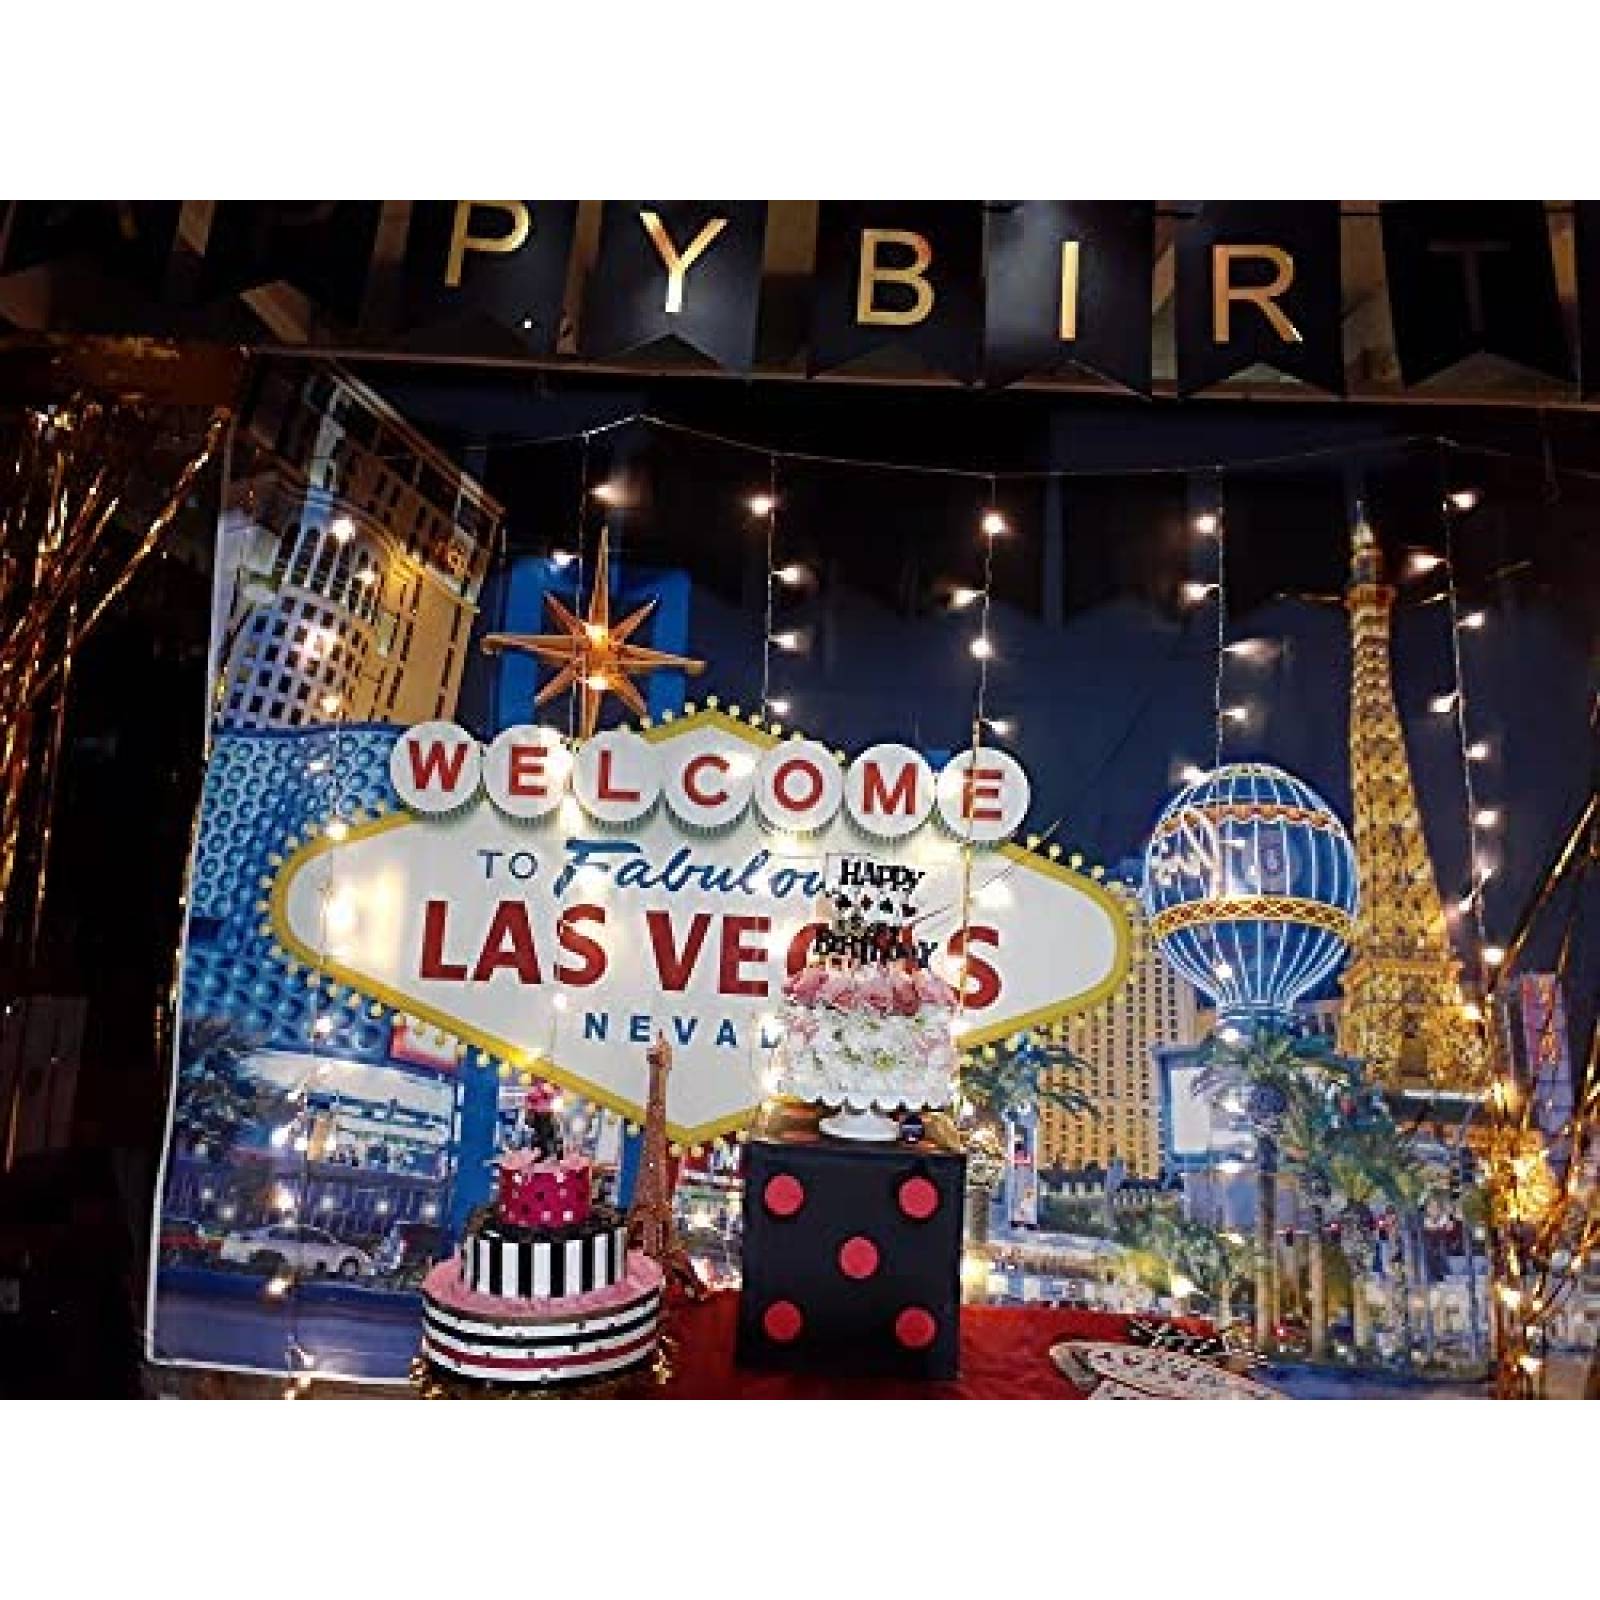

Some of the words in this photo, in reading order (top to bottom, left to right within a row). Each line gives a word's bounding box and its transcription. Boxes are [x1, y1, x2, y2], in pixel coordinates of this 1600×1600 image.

[408, 738, 1004, 822] WELCOME
[478, 850, 539, 881] TO
[552, 837, 827, 897] Fabulou
[419, 899, 609, 988] LAS
[645, 909, 1004, 1011] VES
[583, 1010, 782, 1050] NEVA
